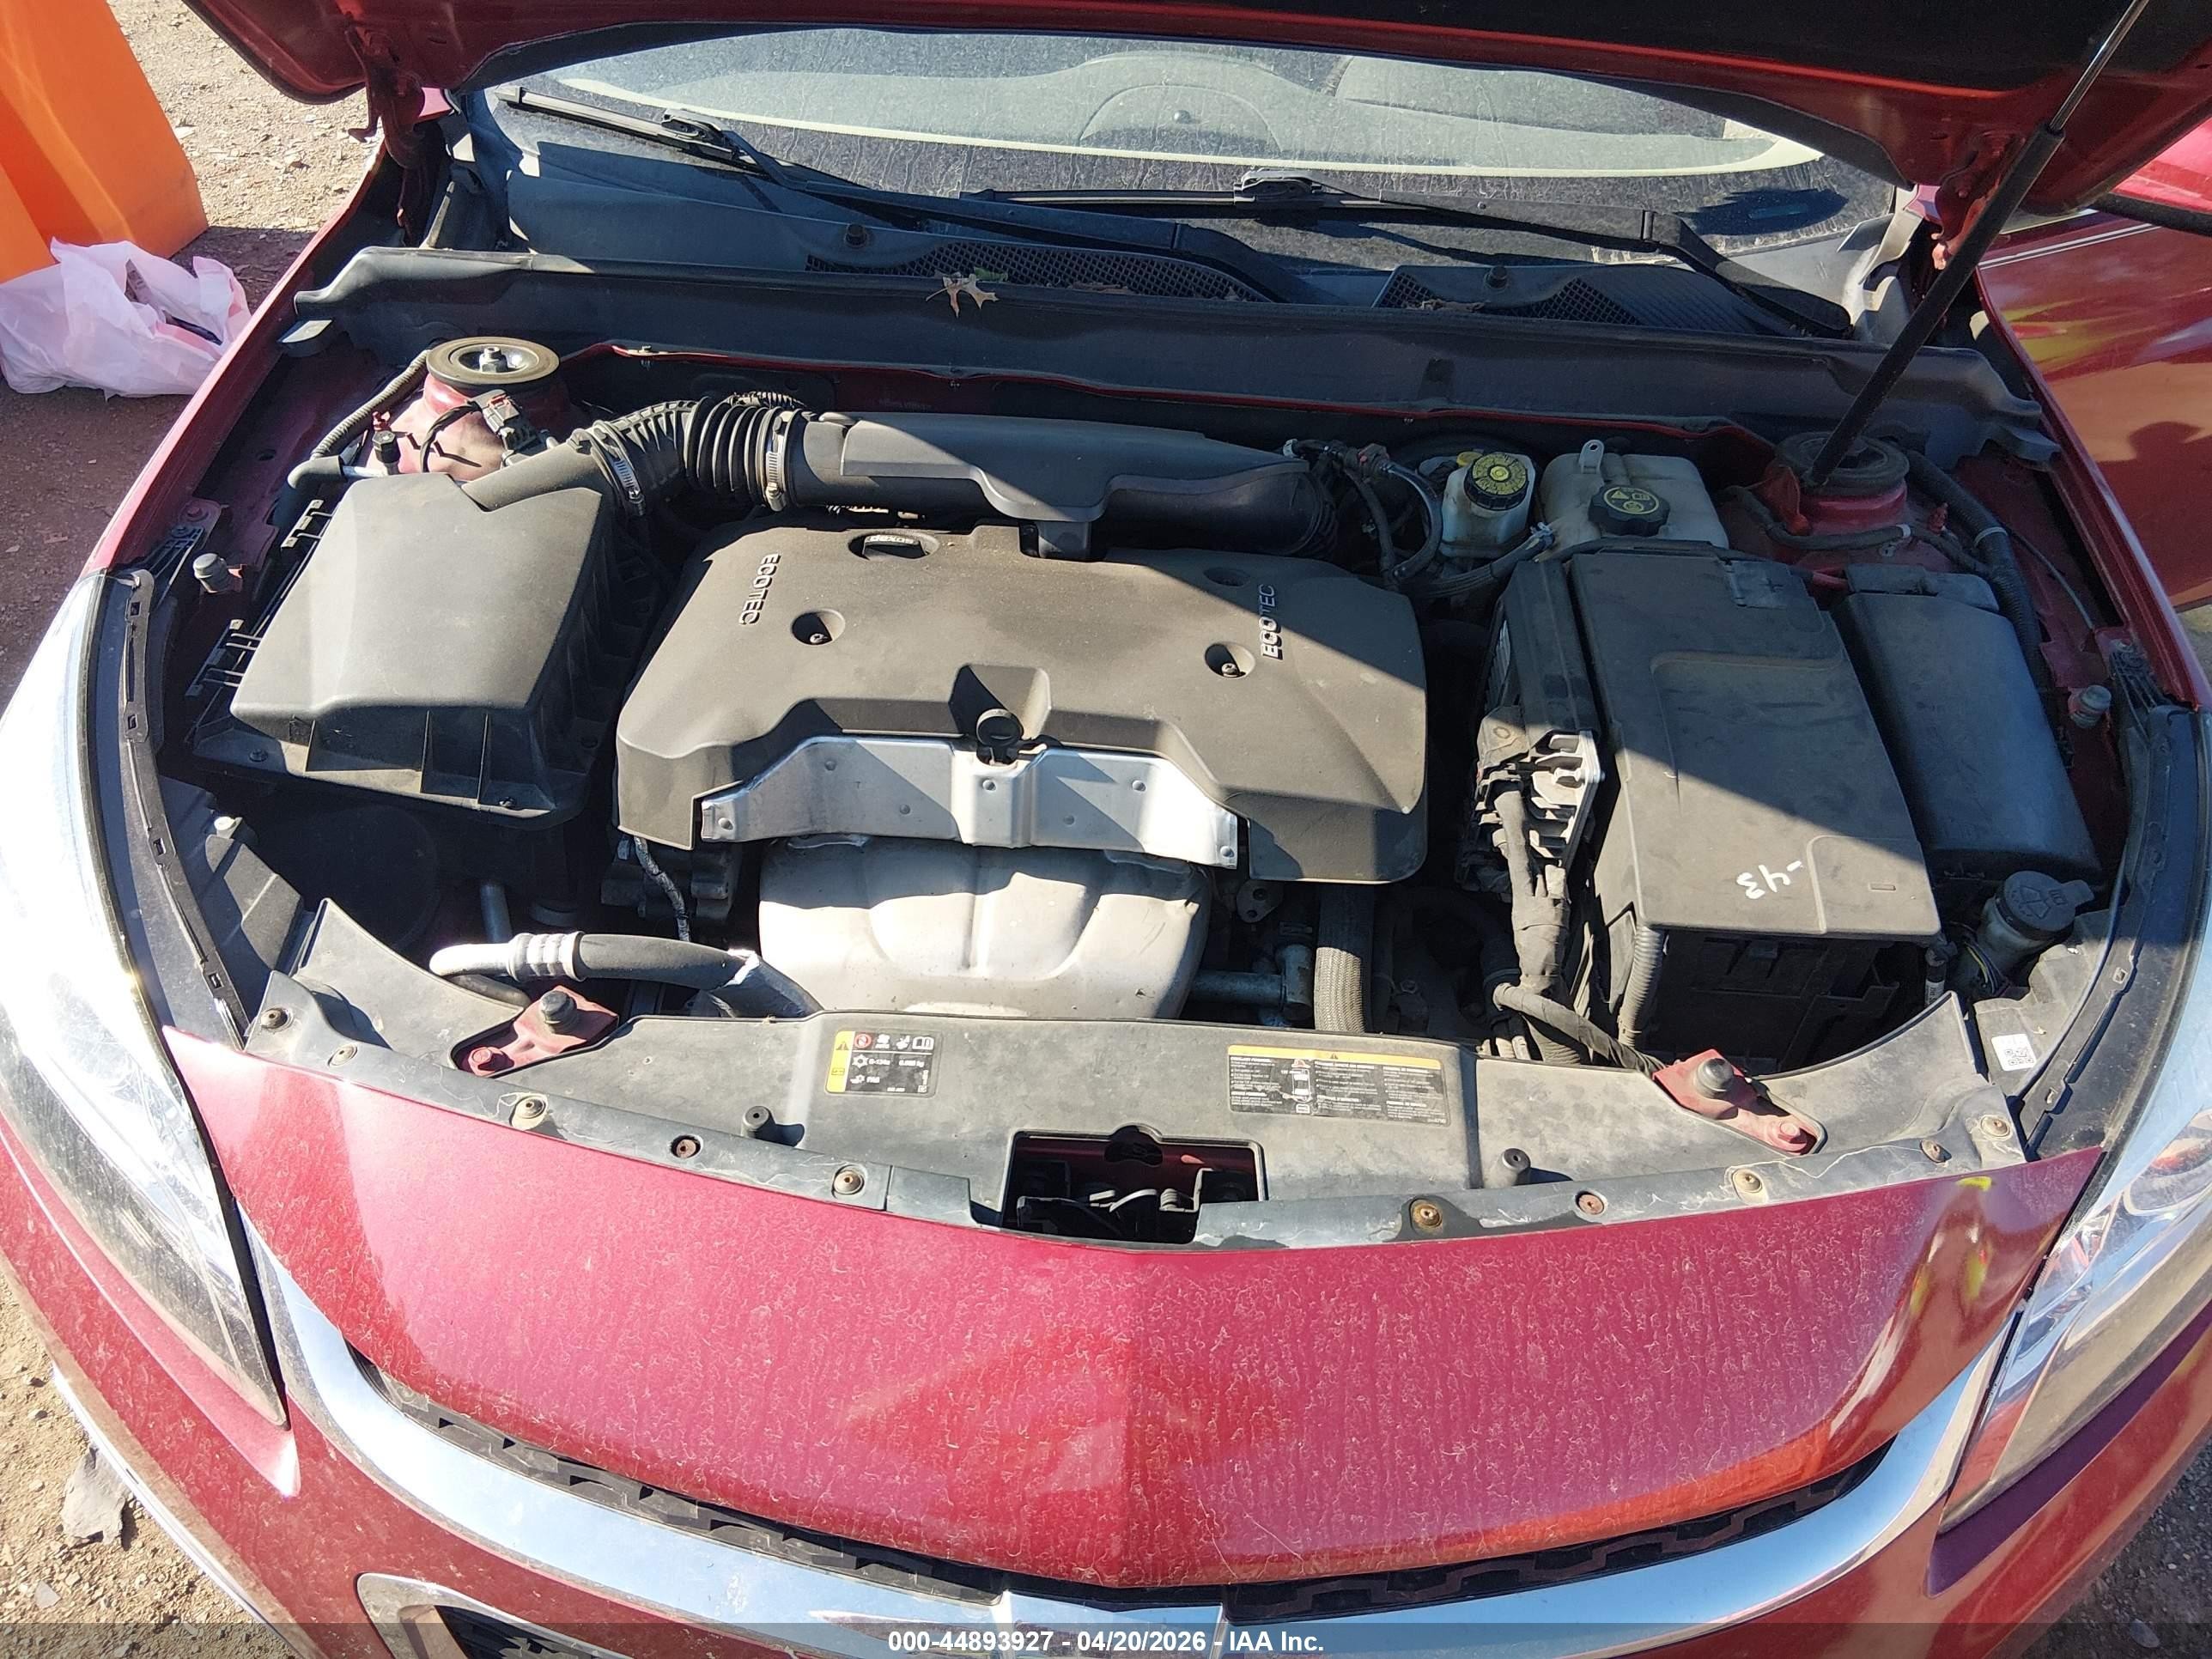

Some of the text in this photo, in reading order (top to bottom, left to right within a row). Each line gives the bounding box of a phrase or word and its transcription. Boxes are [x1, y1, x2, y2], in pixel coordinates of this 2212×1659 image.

[869, 534, 914, 544] dexos
[738, 553, 781, 625] ECOTEC
[1259, 584, 1281, 659] ECOTEC
